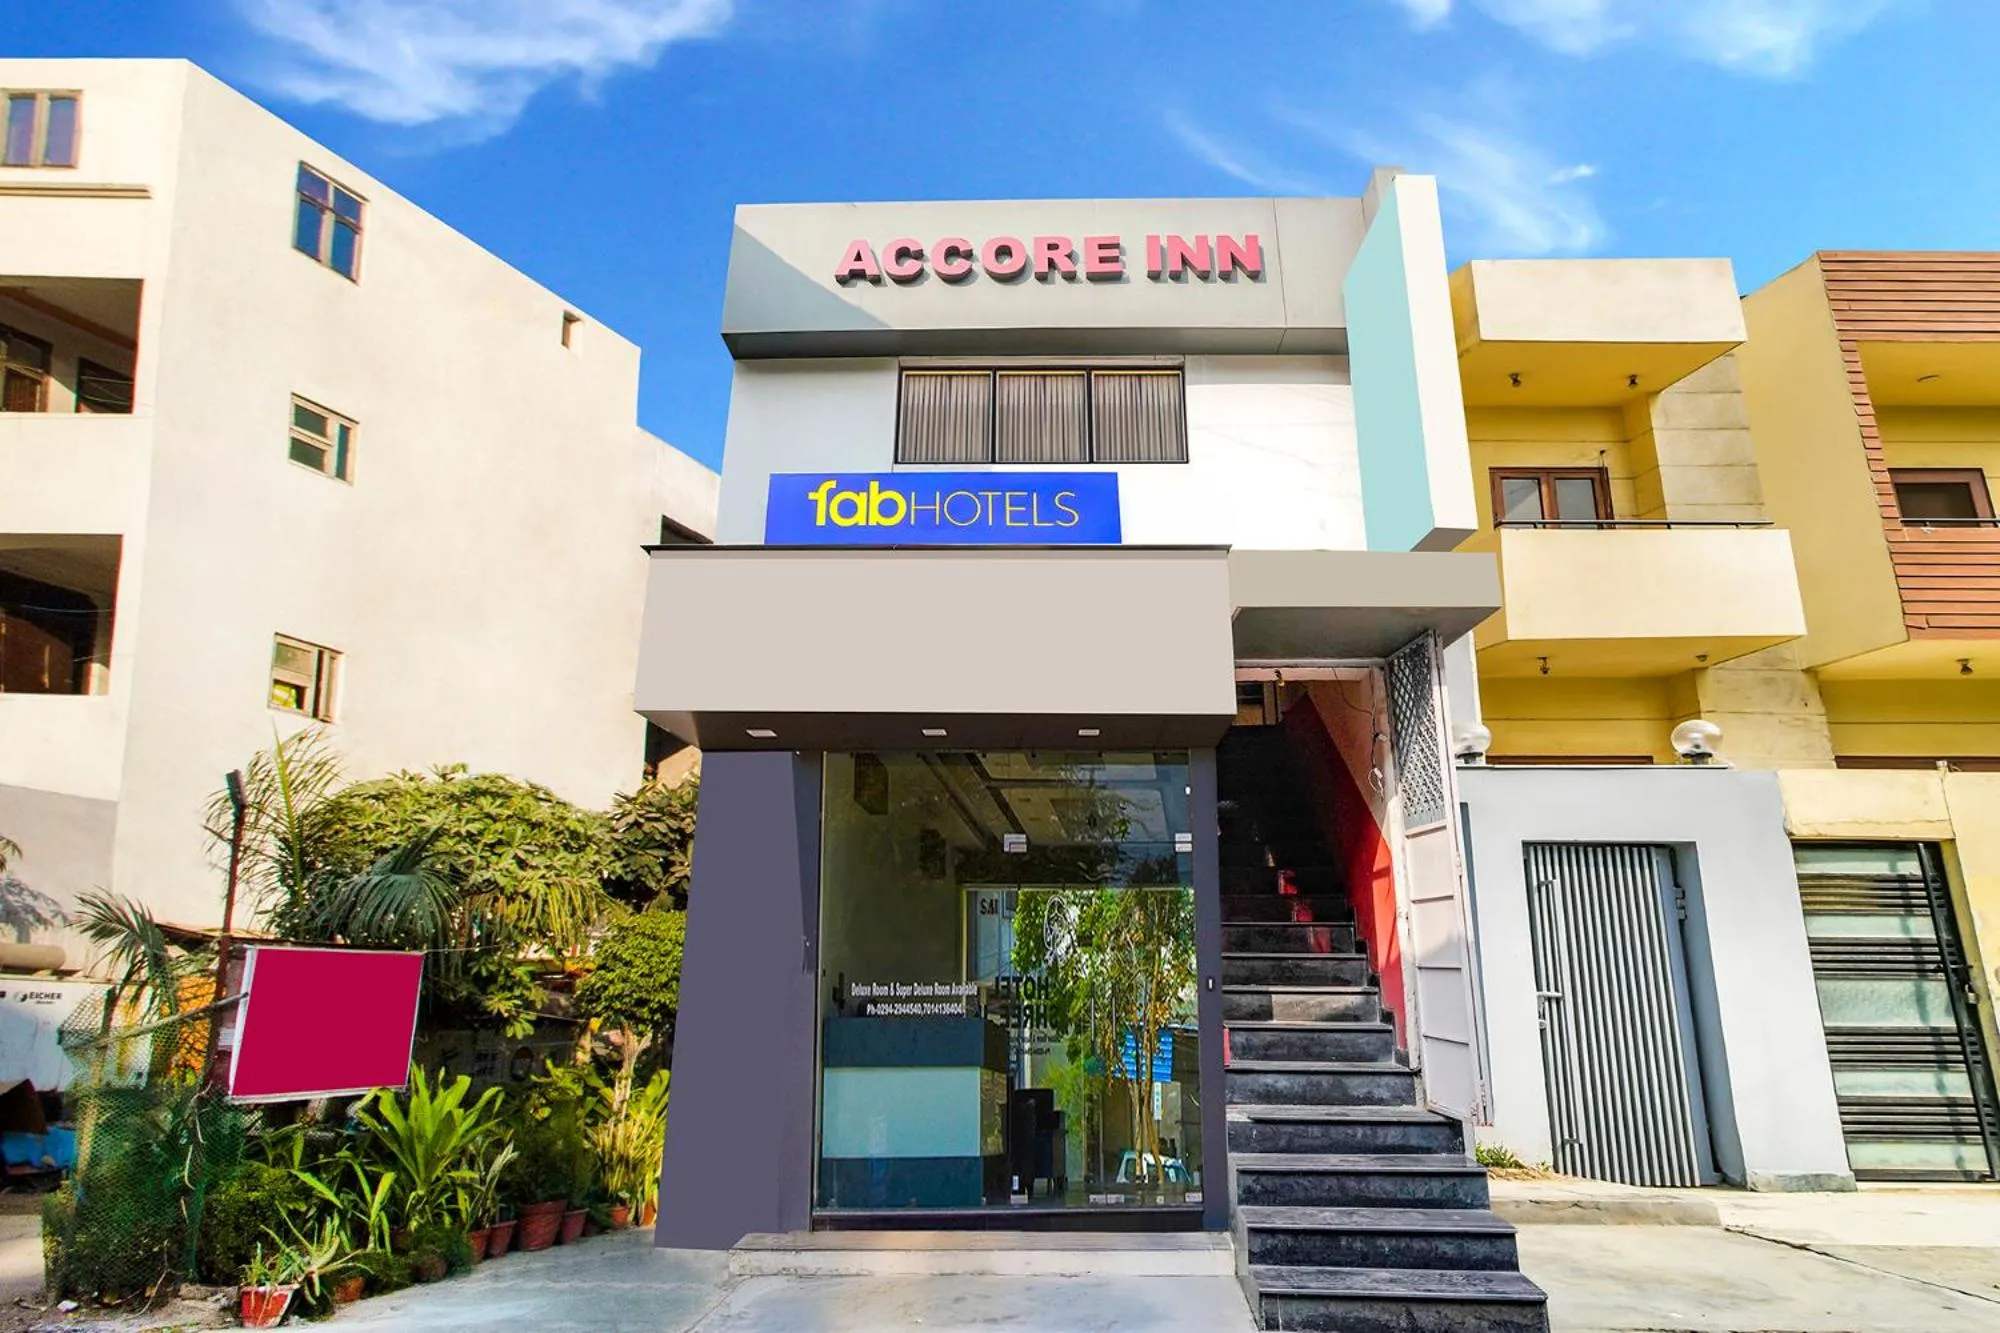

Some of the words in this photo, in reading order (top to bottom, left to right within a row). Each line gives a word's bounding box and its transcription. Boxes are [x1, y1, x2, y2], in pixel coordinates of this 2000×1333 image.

[834, 235, 1124, 282] ACCORE
[1145, 233, 1264, 281] INN
[29, 991, 62, 1000] EICHER
[851, 982, 871, 996] Deluxe
[872, 982, 889, 996] Room
[896, 982, 912, 999] Super
[913, 982, 933, 996] Deluxe
[934, 982, 950, 996] Room
[951, 981, 978, 996] Available
